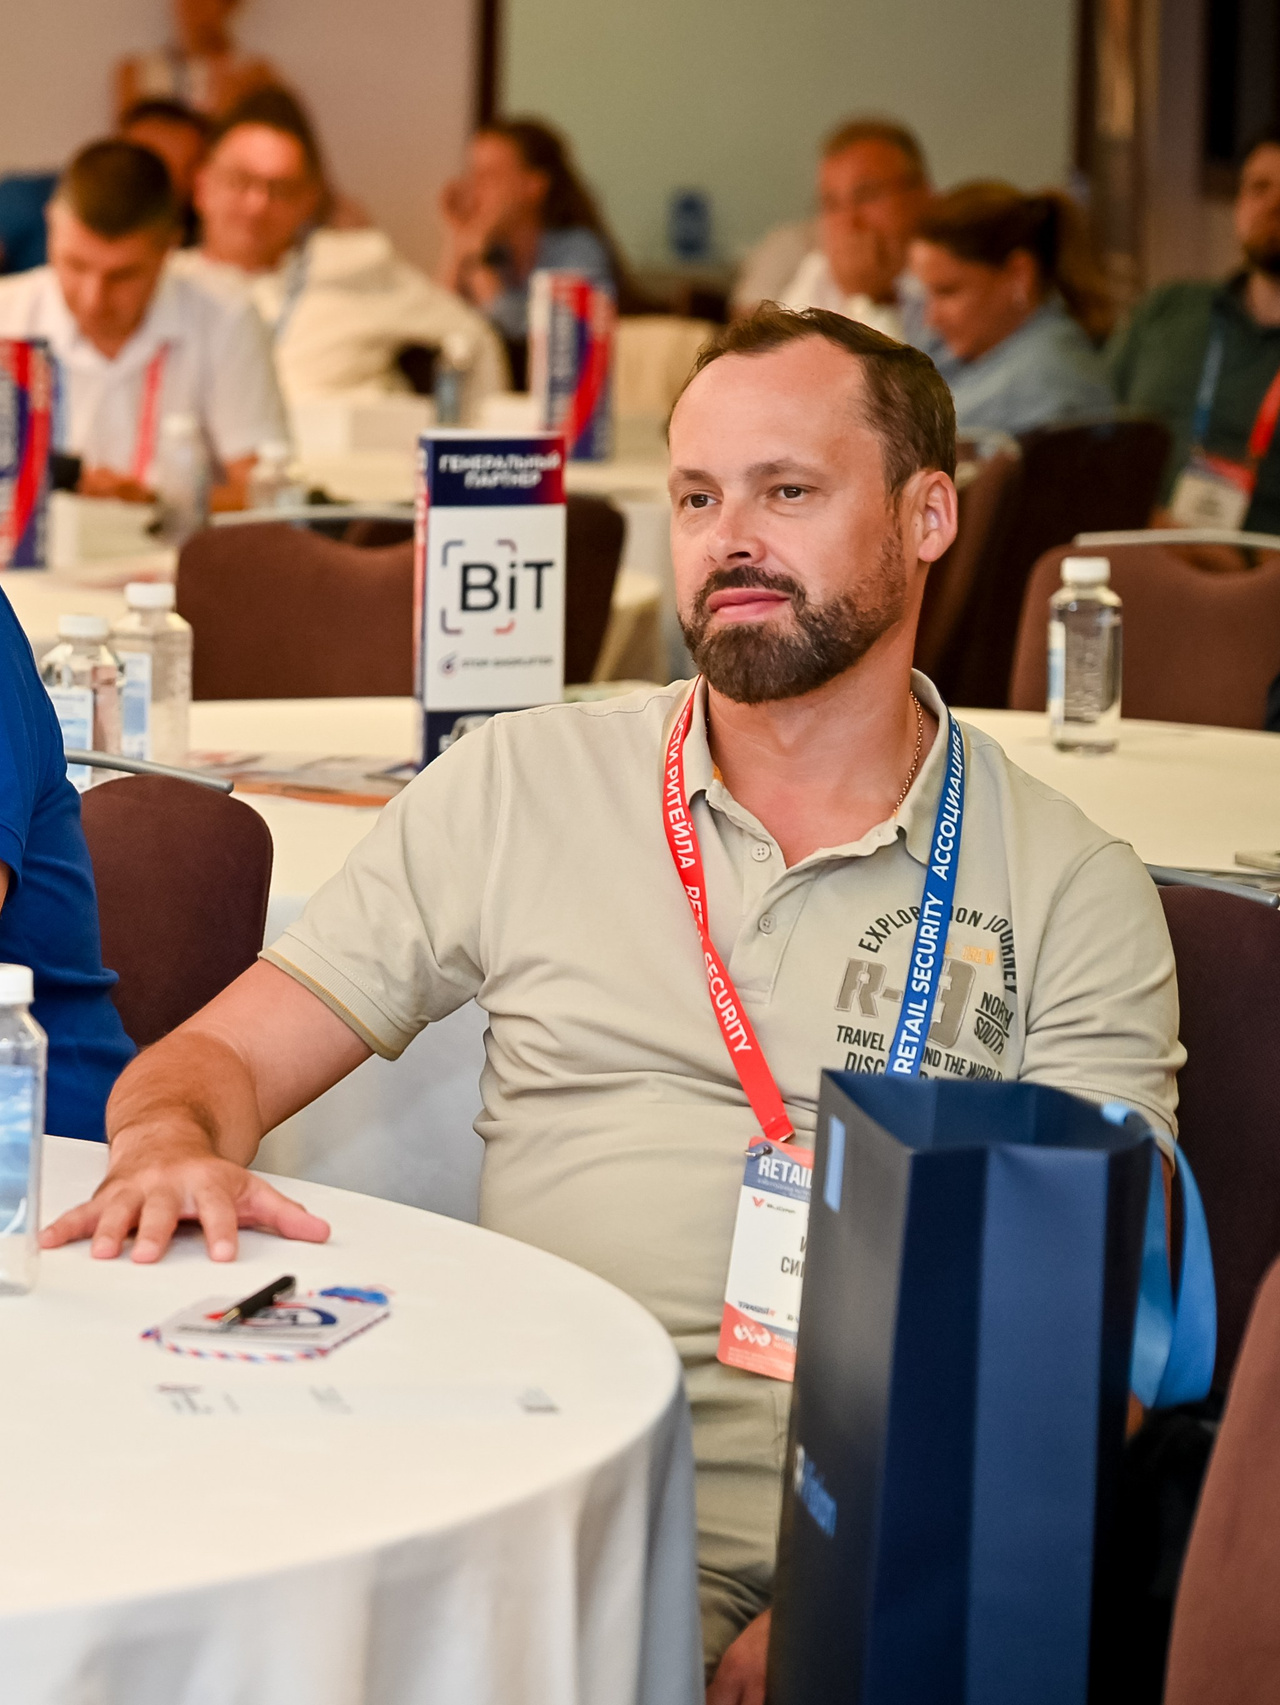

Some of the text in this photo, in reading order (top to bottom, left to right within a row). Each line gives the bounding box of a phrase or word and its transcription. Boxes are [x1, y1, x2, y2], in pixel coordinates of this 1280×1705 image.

[666, 766, 696, 870] РИТЕЙЛА
[931, 735, 965, 881] АССОЦИАЦИЯ
[703, 951, 753, 1053] SECURITY
[892, 998, 928, 1074] RETAIL
[910, 891, 944, 995] SECURITY
[836, 1024, 886, 1052] TRAVEL
[943, 1052, 968, 1076] THE
